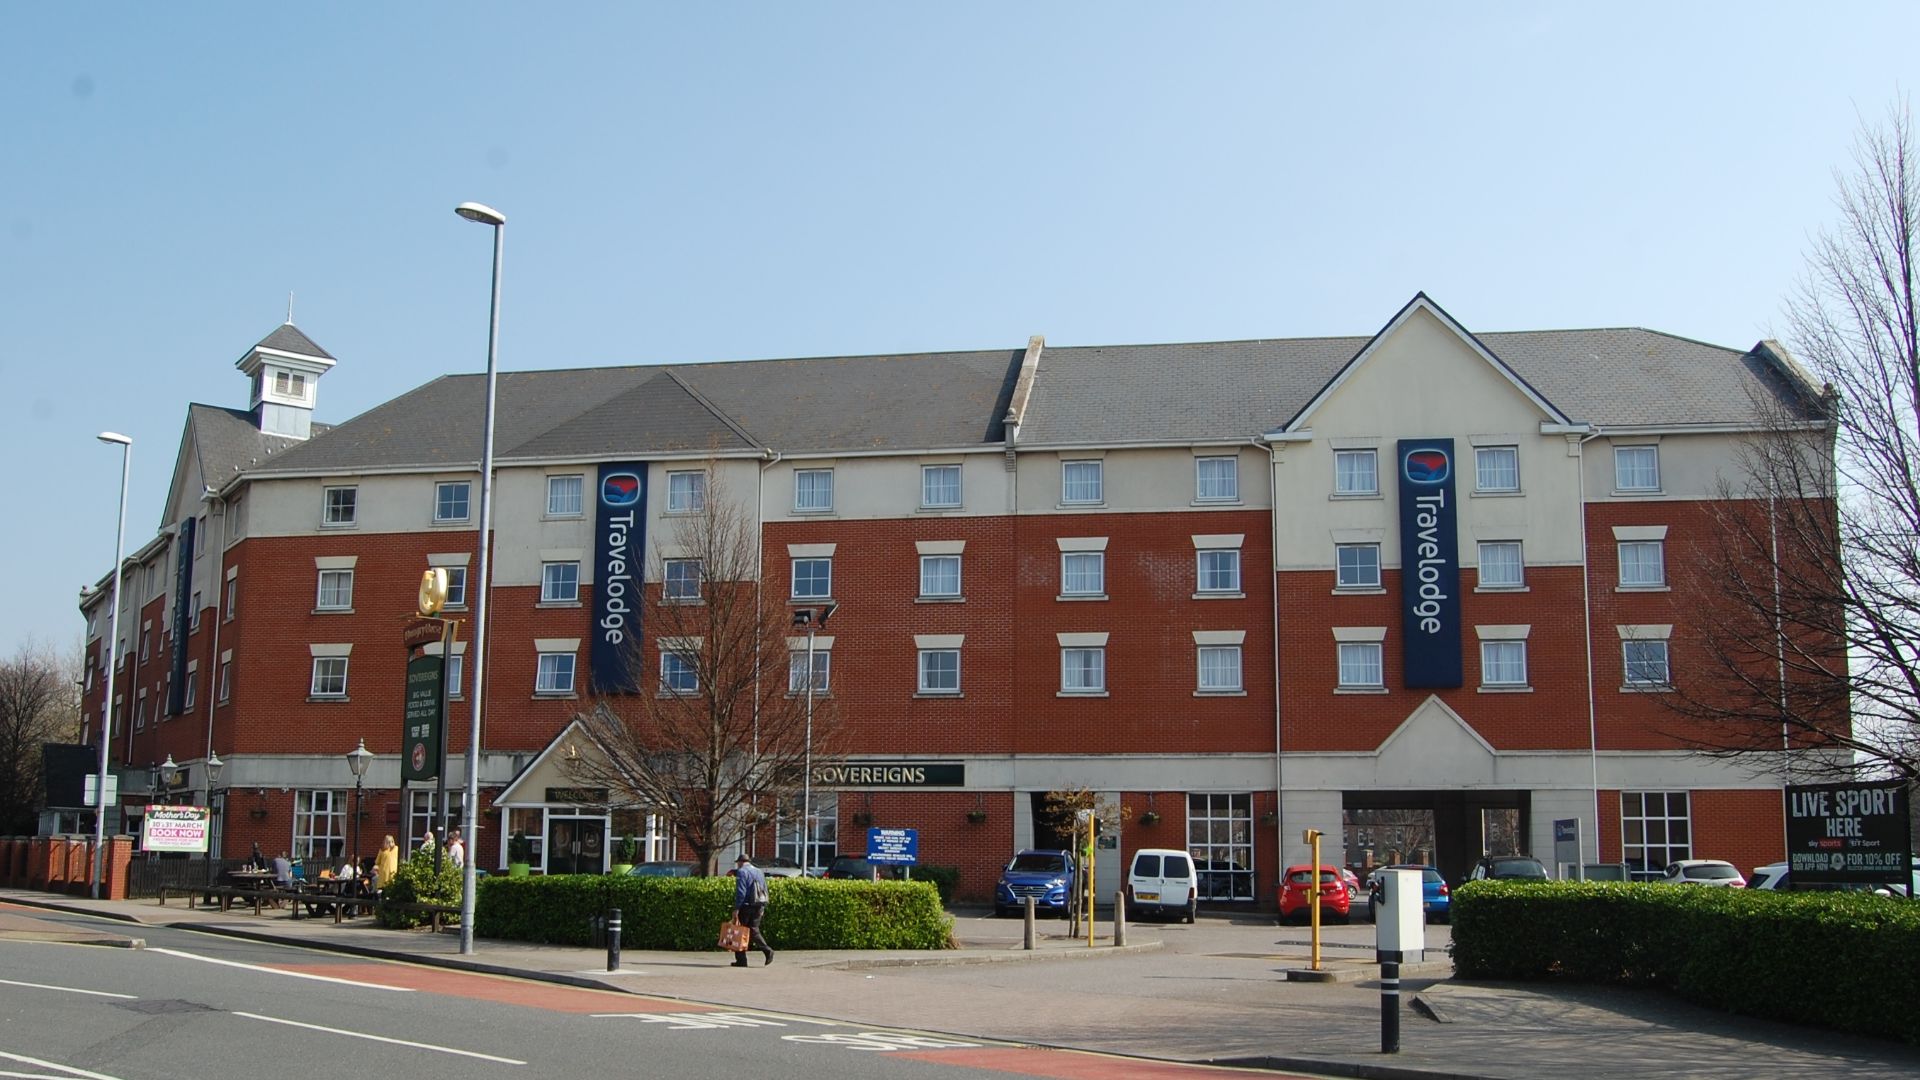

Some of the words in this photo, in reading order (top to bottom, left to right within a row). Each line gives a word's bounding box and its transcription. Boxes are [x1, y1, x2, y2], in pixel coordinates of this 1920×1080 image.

[1413, 489, 1448, 635] Travelodge
[600, 510, 634, 645] Travelodge
[408, 670, 439, 683] SOVEREIGNS
[812, 766, 926, 784] SOVEREIGNS
[554, 790, 600, 801] WELCOME
[1792, 791, 1830, 817] LIVE
[1835, 788, 1897, 816] SPORT
[154, 811, 184, 819] Mother's
[184, 811, 200, 821] Day
[1826, 817, 1863, 837] HERE
[178, 829, 202, 837] NOW
[1808, 840, 1819, 848] sky
[1862, 839, 1880, 847] Sport
[1792, 853, 1829, 863] DOWNLOAD
[1847, 853, 1863, 865] FOR
[1865, 853, 1883, 865] 10%
[1885, 853, 1902, 865] OFF
[1792, 863, 1804, 871] OUR
[1804, 863, 1815, 871] APP
[1816, 862, 1829, 871] NOW
